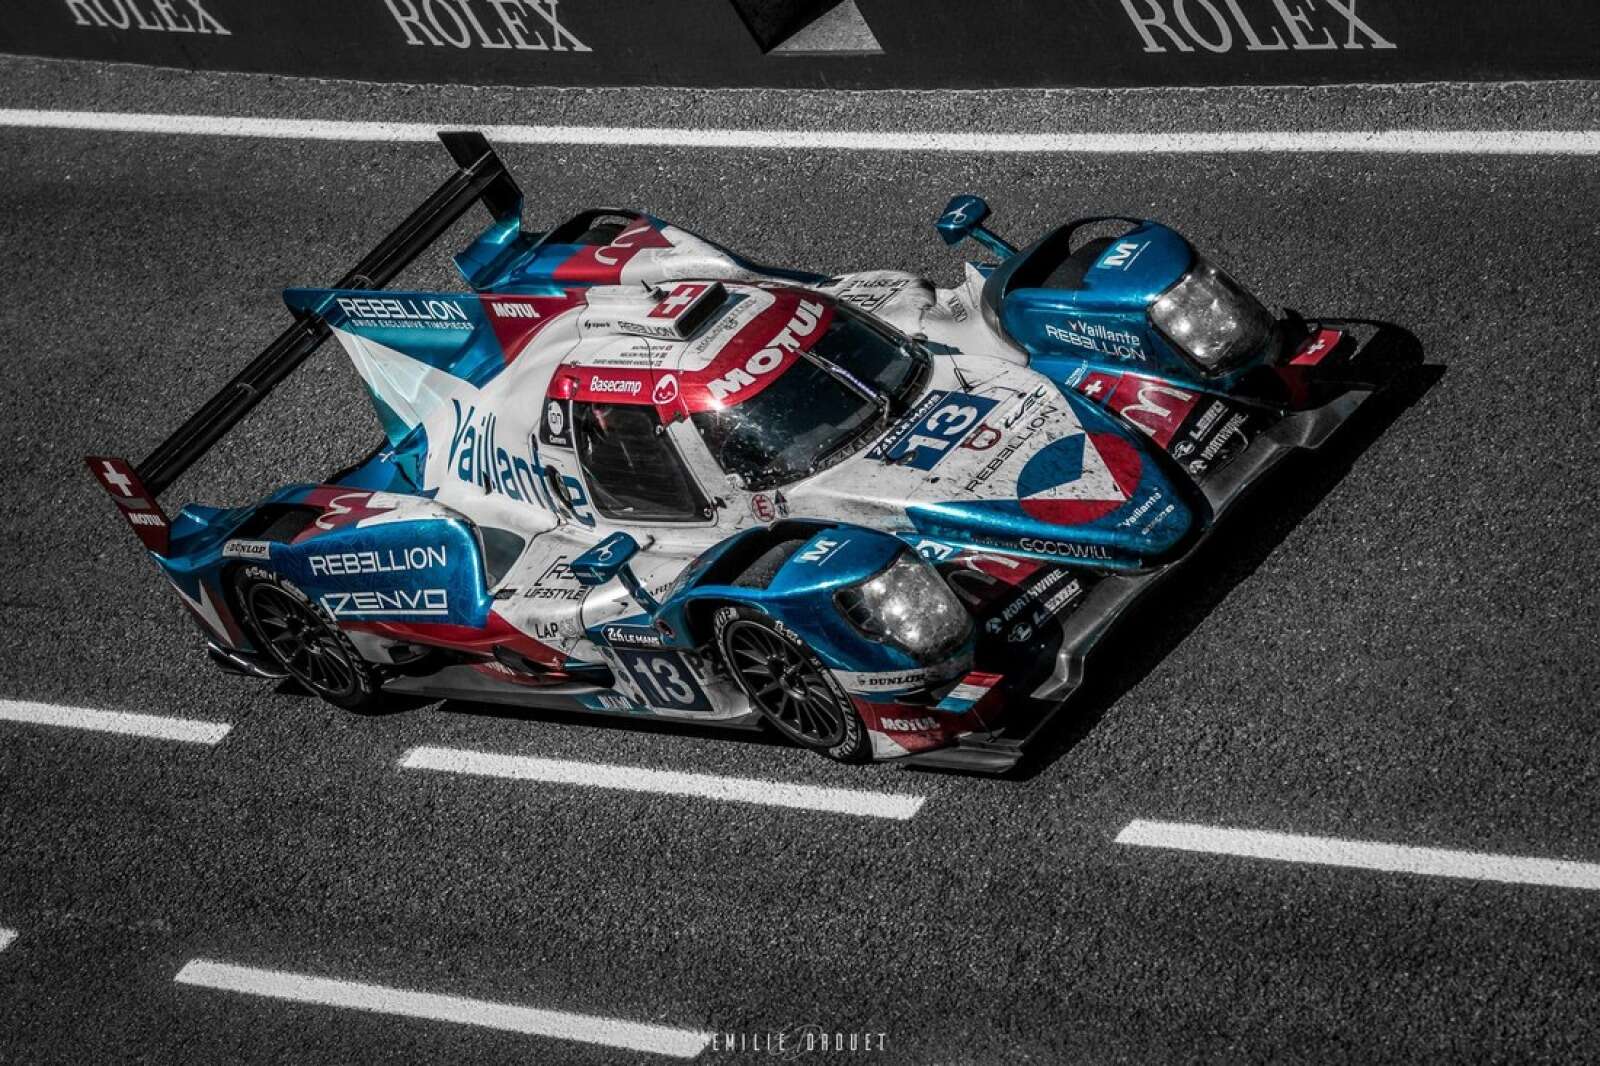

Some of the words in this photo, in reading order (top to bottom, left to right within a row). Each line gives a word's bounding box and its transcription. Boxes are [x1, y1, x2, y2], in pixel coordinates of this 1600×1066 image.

[384, 0, 593, 52] ROLEX
[1120, 0, 1398, 52] ROLEX
[492, 302, 541, 318] MOTUL
[707, 300, 825, 401] MOTUL
[590, 376, 642, 396] Basecamp
[908, 404, 978, 451] 13
[447, 398, 596, 529] Vaillante
[128, 512, 167, 527] MOTUL
[634, 656, 695, 704] 13
[880, 716, 941, 732] MOTUL
